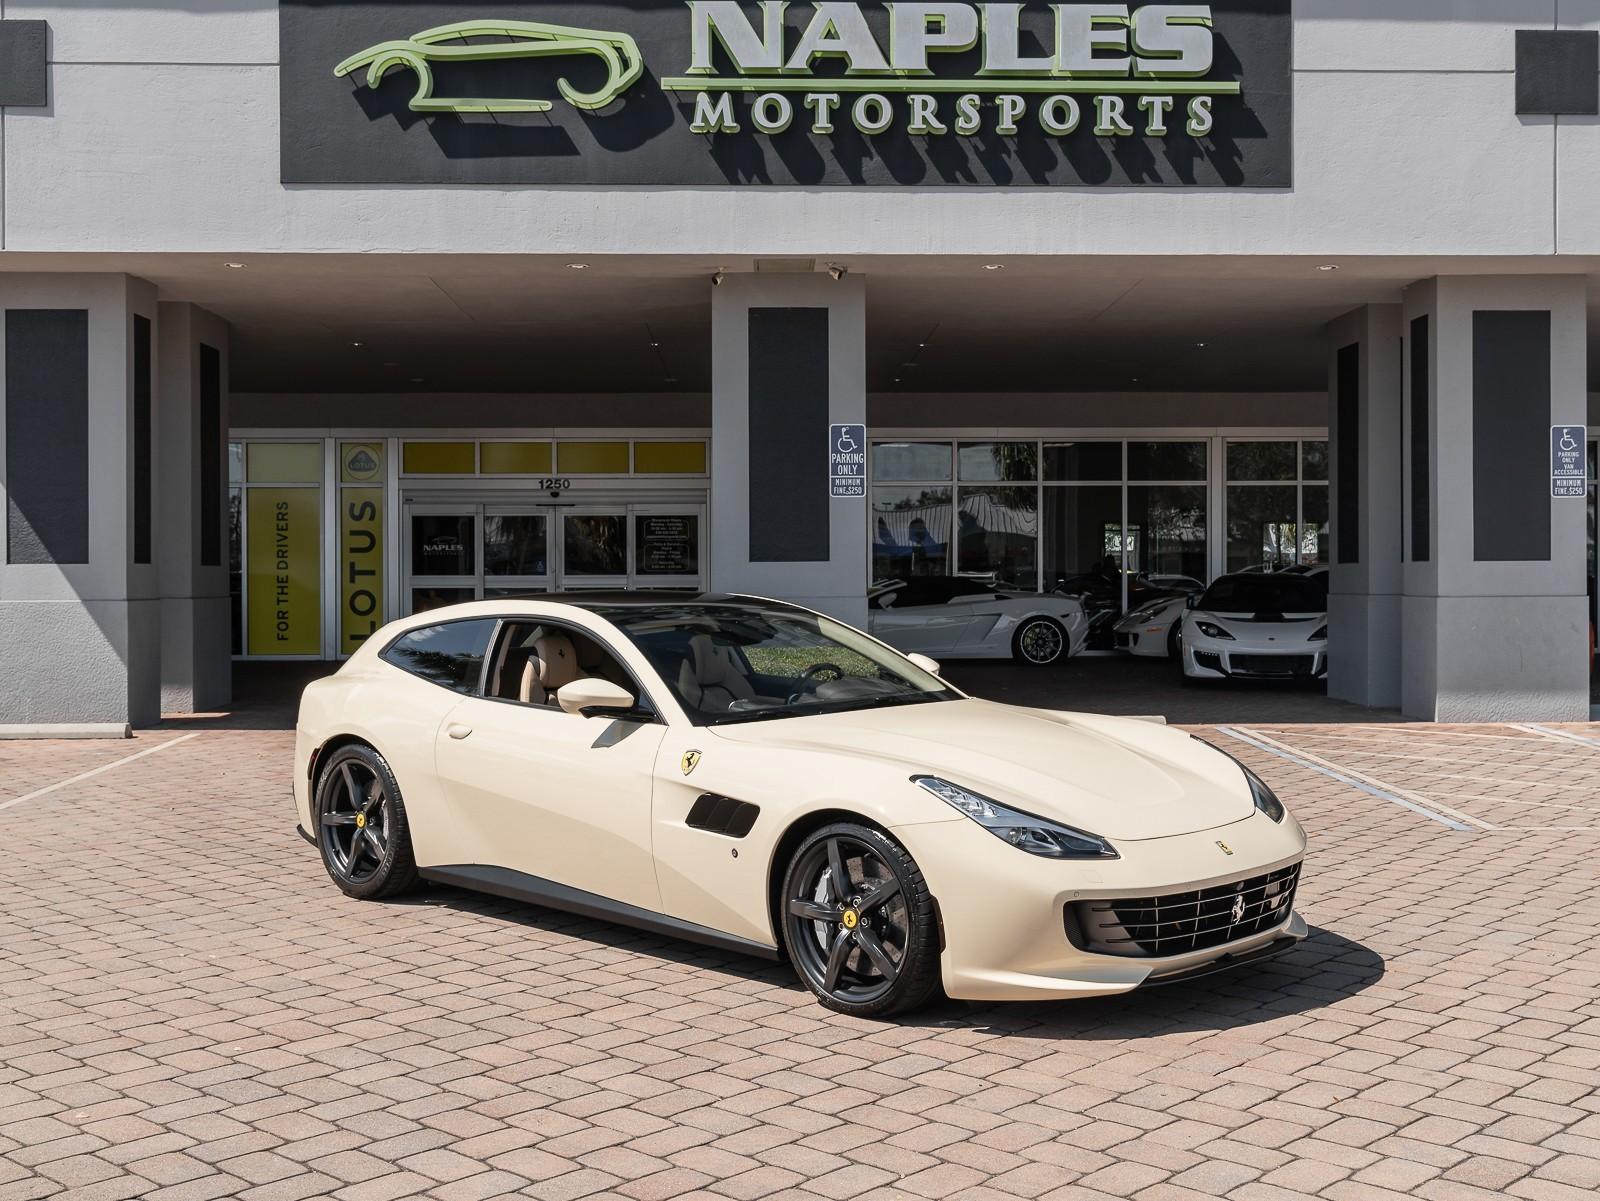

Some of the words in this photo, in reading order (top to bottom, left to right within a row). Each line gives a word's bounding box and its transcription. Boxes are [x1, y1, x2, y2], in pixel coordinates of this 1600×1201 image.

[683, 1, 1213, 77] NAPLES
[689, 91, 1213, 136] MOTORSPORTS
[832, 453, 864, 463] PARKING
[838, 465, 857, 474] ONLY
[538, 479, 571, 489] 1250
[276, 501, 289, 570] DRIVERS
[349, 501, 377, 641] LOTUS
[276, 575, 289, 606] THE
[276, 609, 289, 641] FOR
